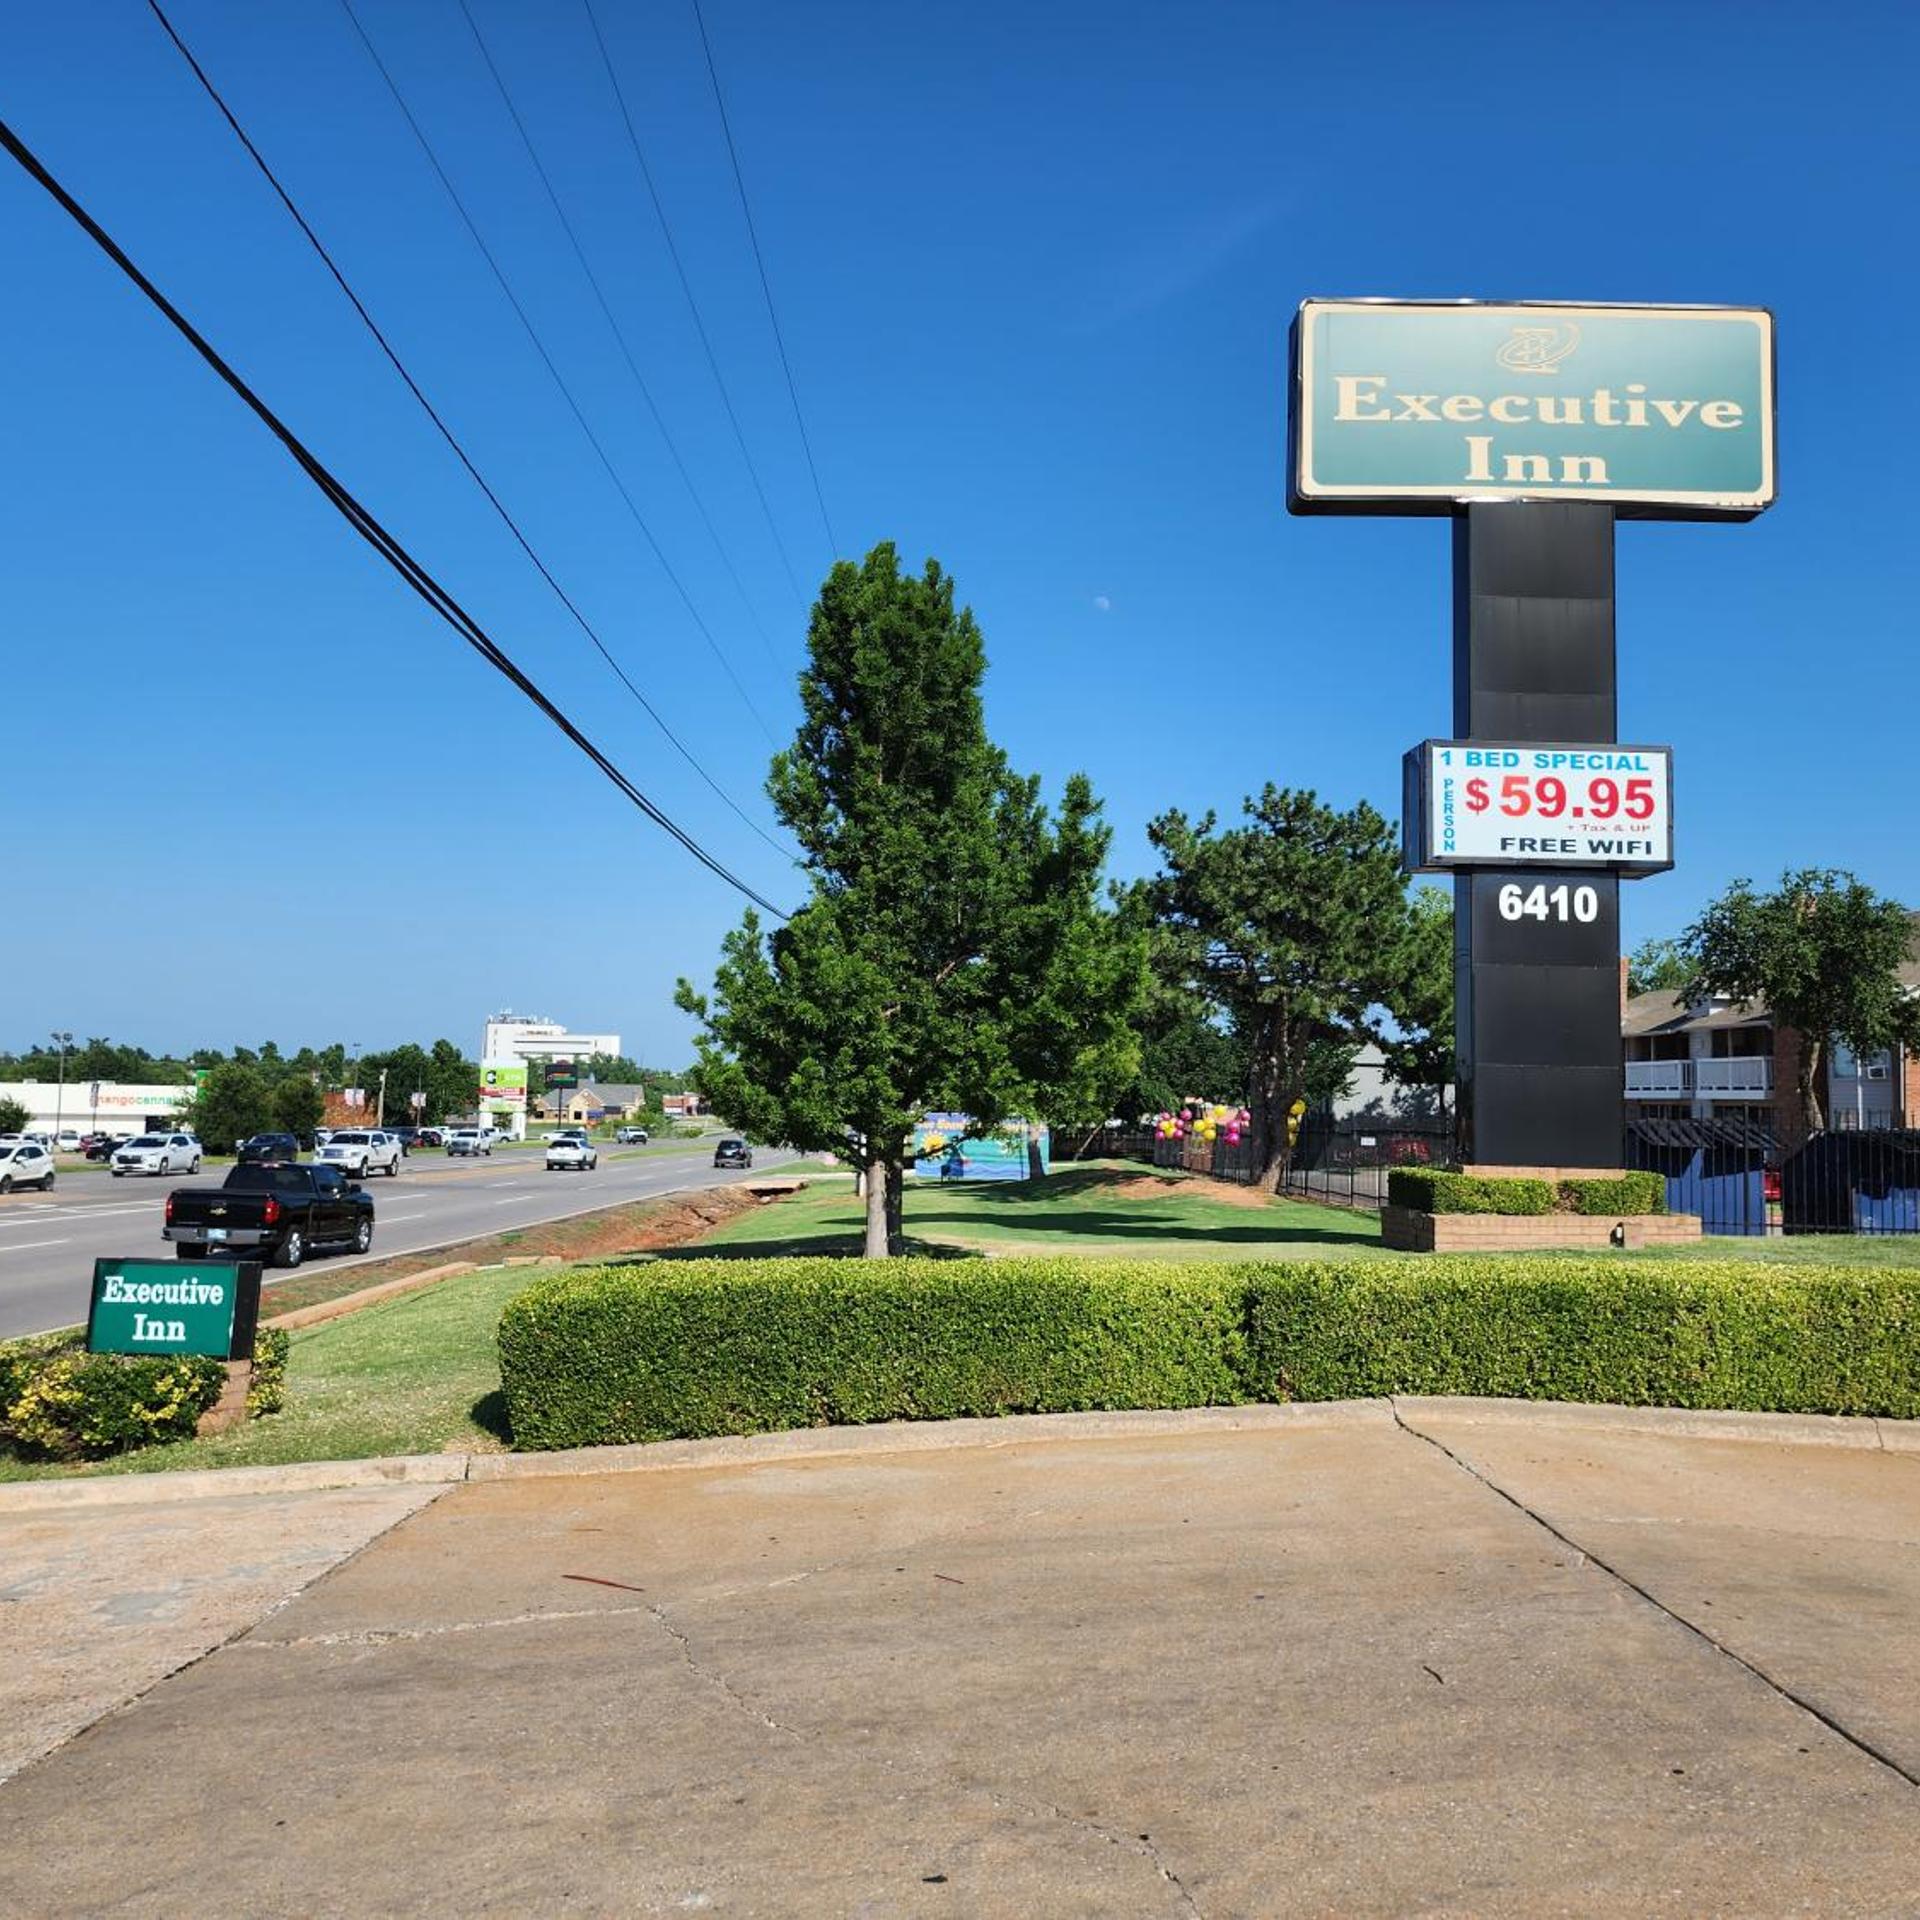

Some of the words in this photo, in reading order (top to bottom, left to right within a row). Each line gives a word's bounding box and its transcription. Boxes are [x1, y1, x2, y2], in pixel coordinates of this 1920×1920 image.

[1333, 376, 1744, 429] Executive
[1464, 436, 1611, 484] Inn
[1440, 751, 1451, 766] 1
[1466, 751, 1520, 768] BED
[1534, 753, 1649, 771] SPECIAL
[1465, 775, 1656, 820] $59.95
[1443, 778, 1455, 852] PERSON
[1580, 823, 1607, 832] Tax
[1500, 838, 1577, 853] FREE
[1587, 839, 1652, 855] WIFI
[1498, 884, 1598, 922] 6410
[102, 1275, 224, 1305] Executive
[132, 1313, 186, 1341] Inn
